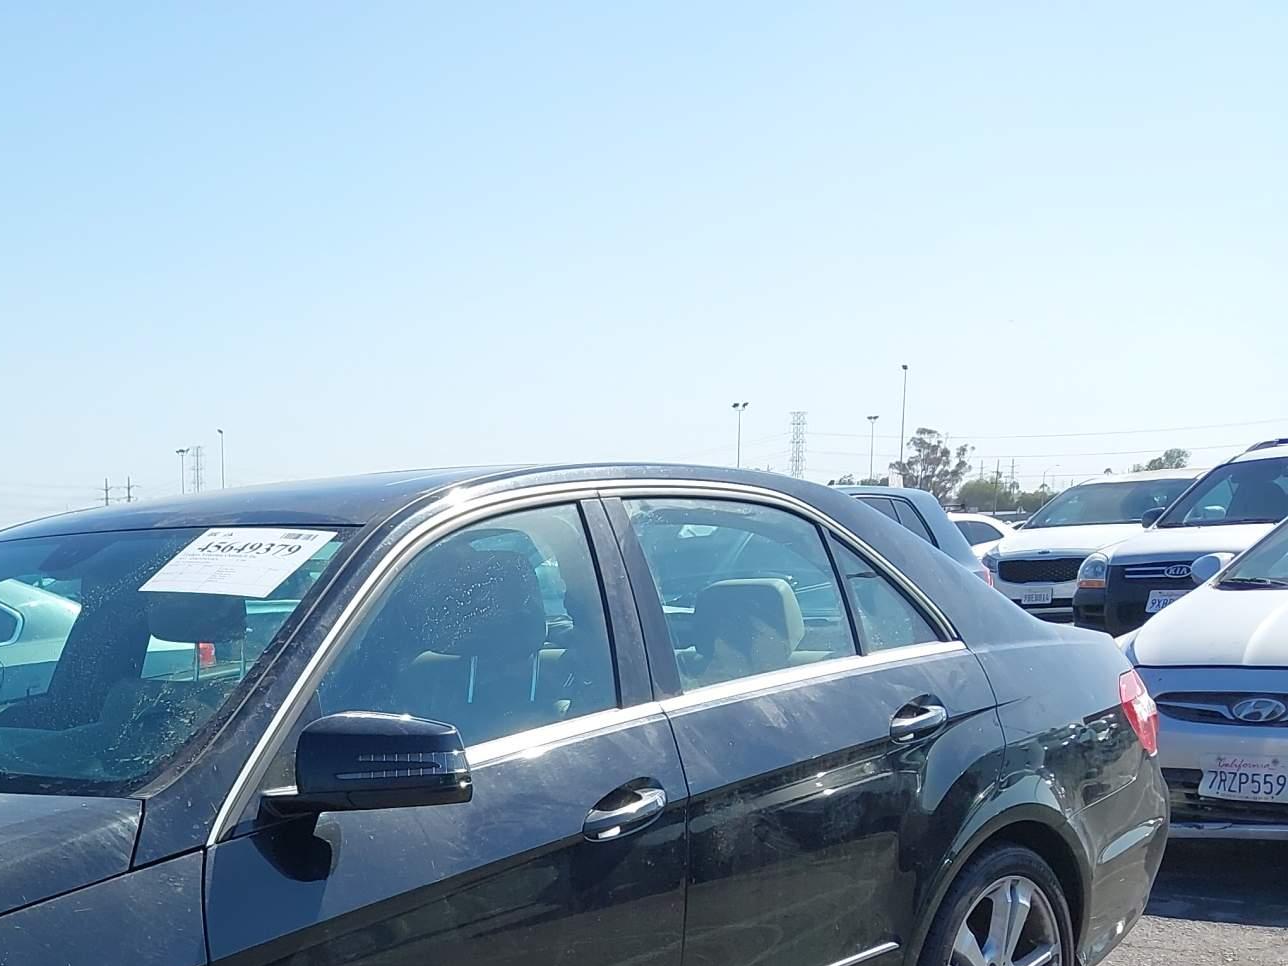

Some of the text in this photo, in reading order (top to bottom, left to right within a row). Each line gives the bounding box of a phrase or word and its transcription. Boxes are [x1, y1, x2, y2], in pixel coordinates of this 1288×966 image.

[197, 541, 303, 557] 45649379
[1169, 567, 1188, 575] KIA
[1208, 770, 1287, 796] 7RZP559
